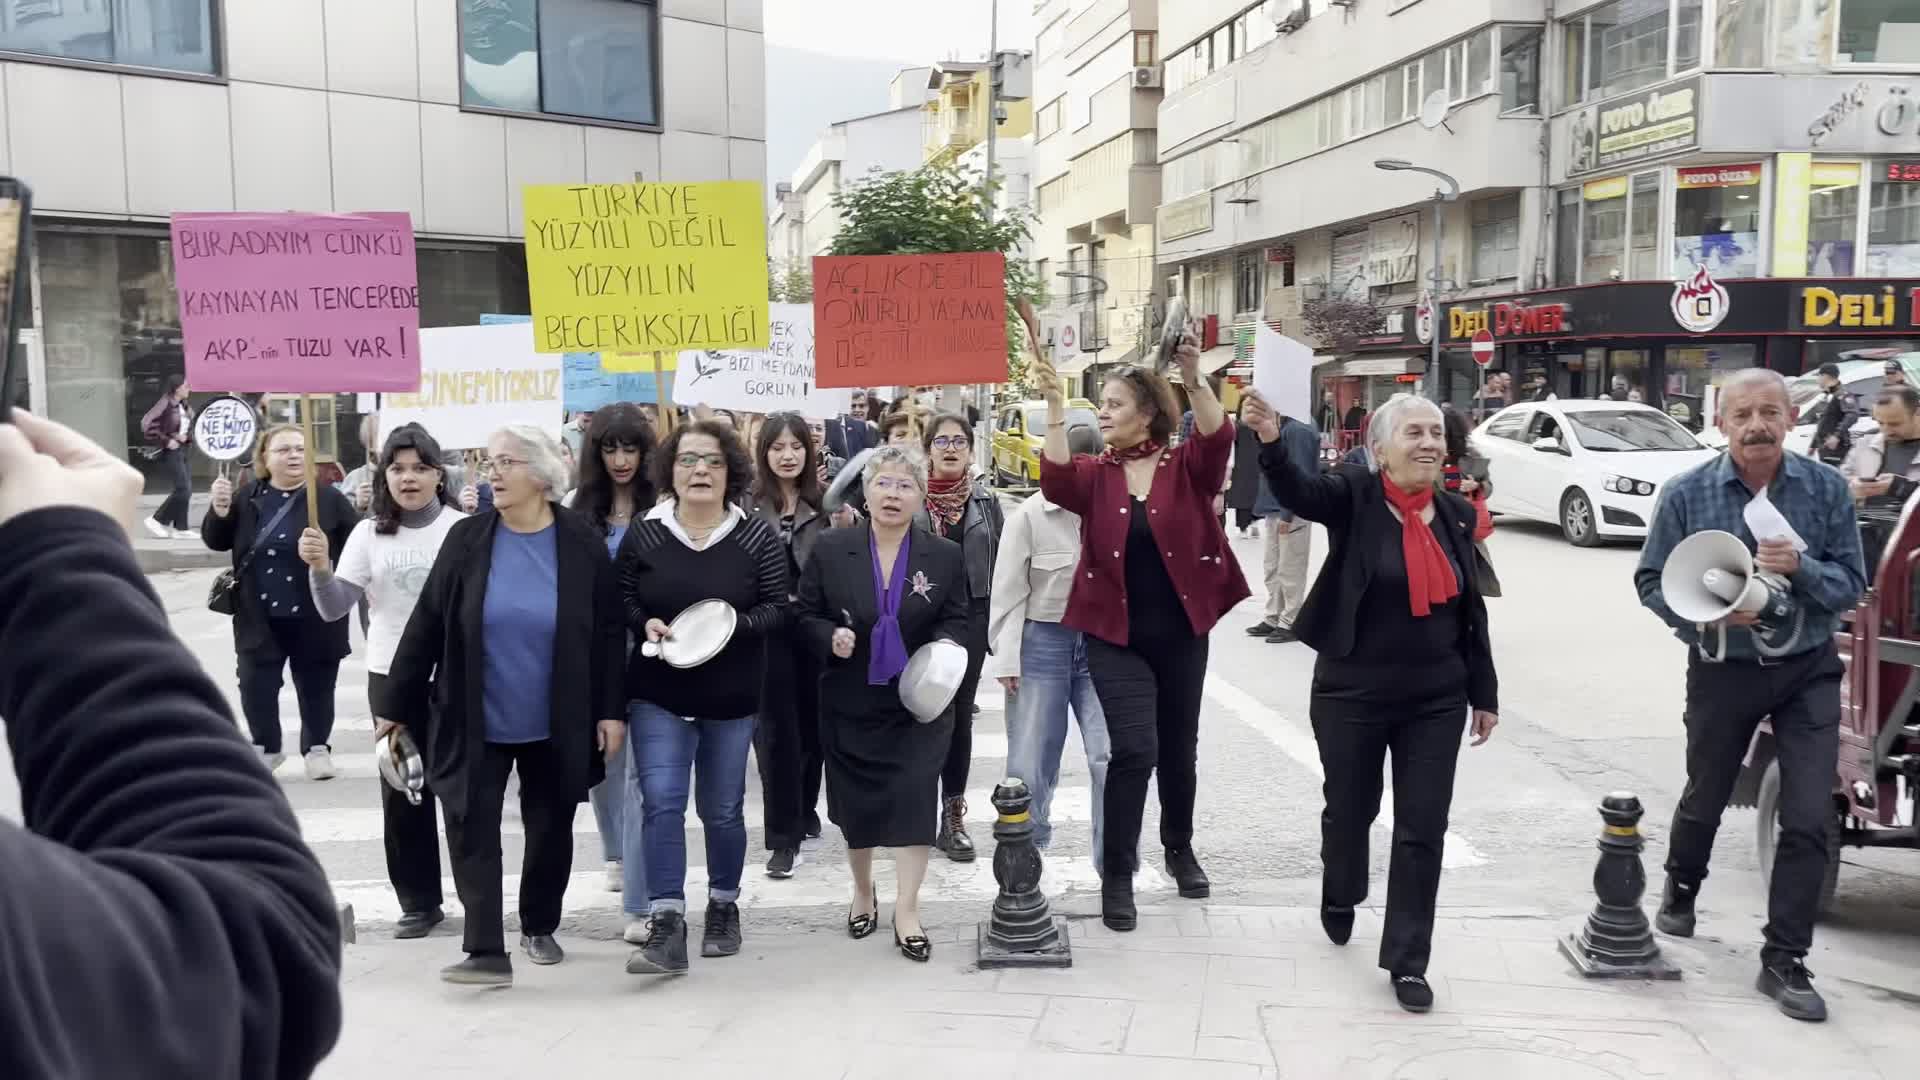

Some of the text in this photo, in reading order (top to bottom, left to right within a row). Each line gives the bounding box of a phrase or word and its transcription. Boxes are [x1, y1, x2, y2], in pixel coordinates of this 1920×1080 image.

[567, 184, 699, 218] TÜRKİYE
[179, 230, 312, 259] BURADAYIM
[531, 215, 737, 251] YÜZYILI DEĞİL
[567, 263, 695, 297] YÜZYILIN
[184, 284, 419, 316] KAYNAYAN TENCEREDE
[545, 305, 757, 350] BECERİKSİZLİĞİ
[285, 337, 332, 357] TUZU
